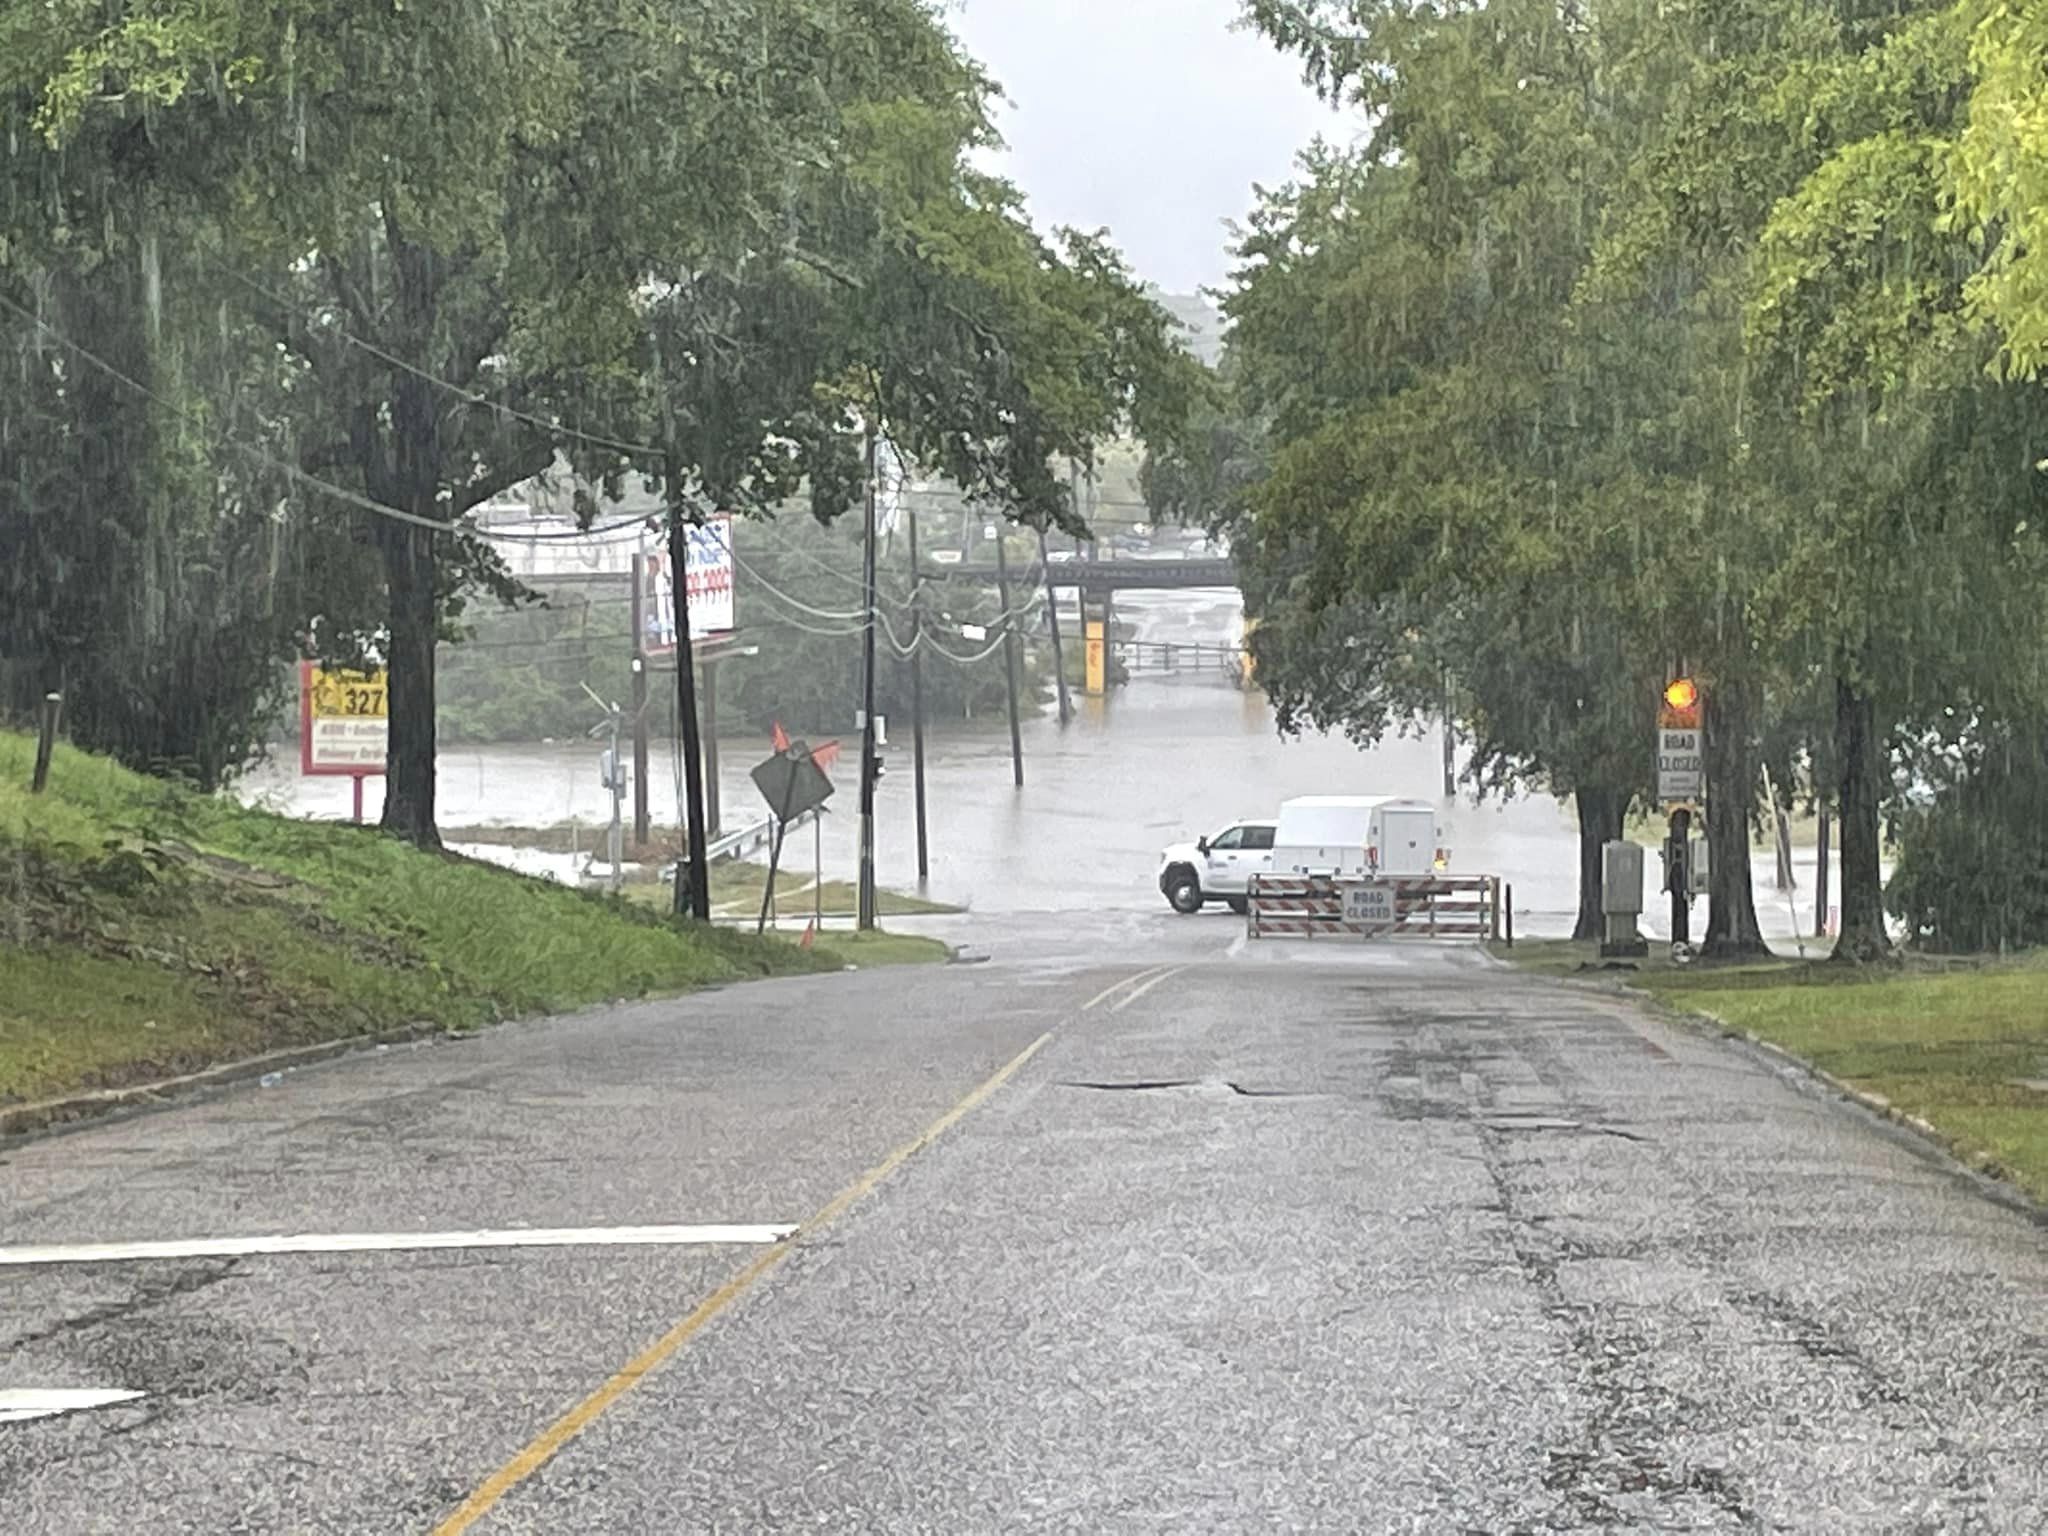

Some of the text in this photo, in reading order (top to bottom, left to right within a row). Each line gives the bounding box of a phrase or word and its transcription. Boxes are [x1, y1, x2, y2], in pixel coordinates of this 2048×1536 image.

[345, 687, 383, 715] 327
[1664, 734, 1695, 750] ROAD
[1660, 756, 1701, 772] CLOSED
[1353, 891, 1384, 905] ROAD
[1347, 906, 1391, 919] CLOSED
